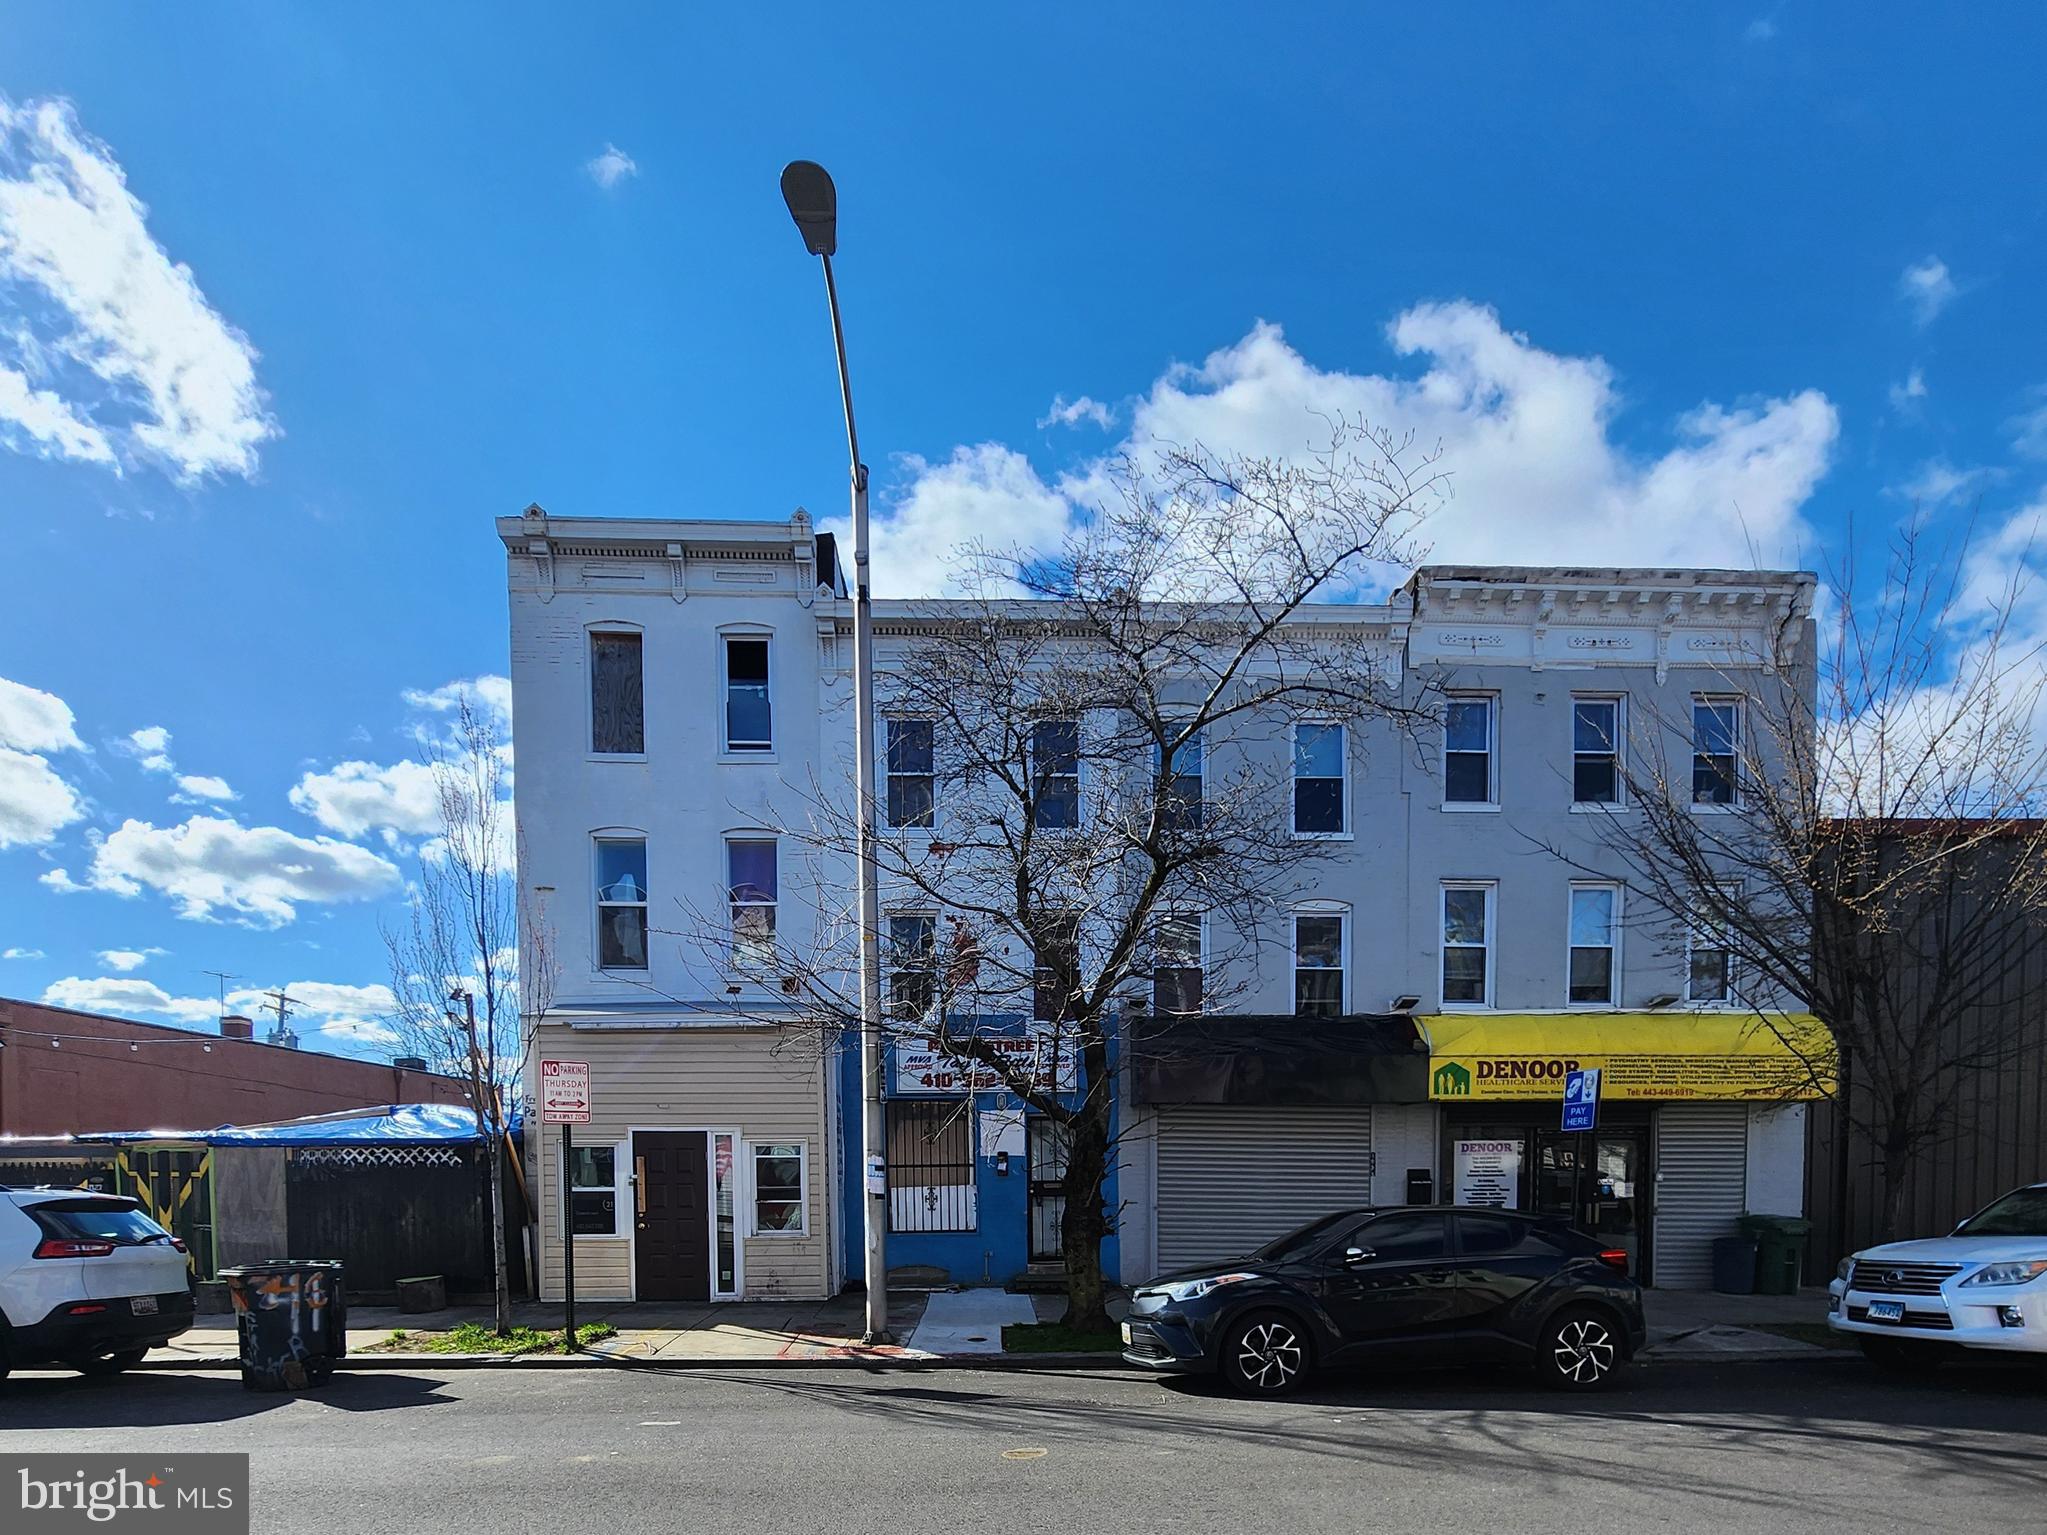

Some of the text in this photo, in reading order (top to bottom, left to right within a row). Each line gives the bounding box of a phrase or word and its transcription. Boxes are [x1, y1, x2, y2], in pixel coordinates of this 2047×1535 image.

[905, 1055, 932, 1063] MVA
[1043, 1055, 1070, 1063] MA
[544, 1063, 587, 1075] NO PARKING
[545, 1079, 587, 1089] THURSDAY
[1476, 1079, 1565, 1087] HEALTHCARE SERVI
[1627, 1088, 1640, 1096] Tel:
[1570, 1107, 1586, 1116] PAY
[1567, 1116, 1589, 1127] HERE
[1461, 1143, 1513, 1153] DENOOR
